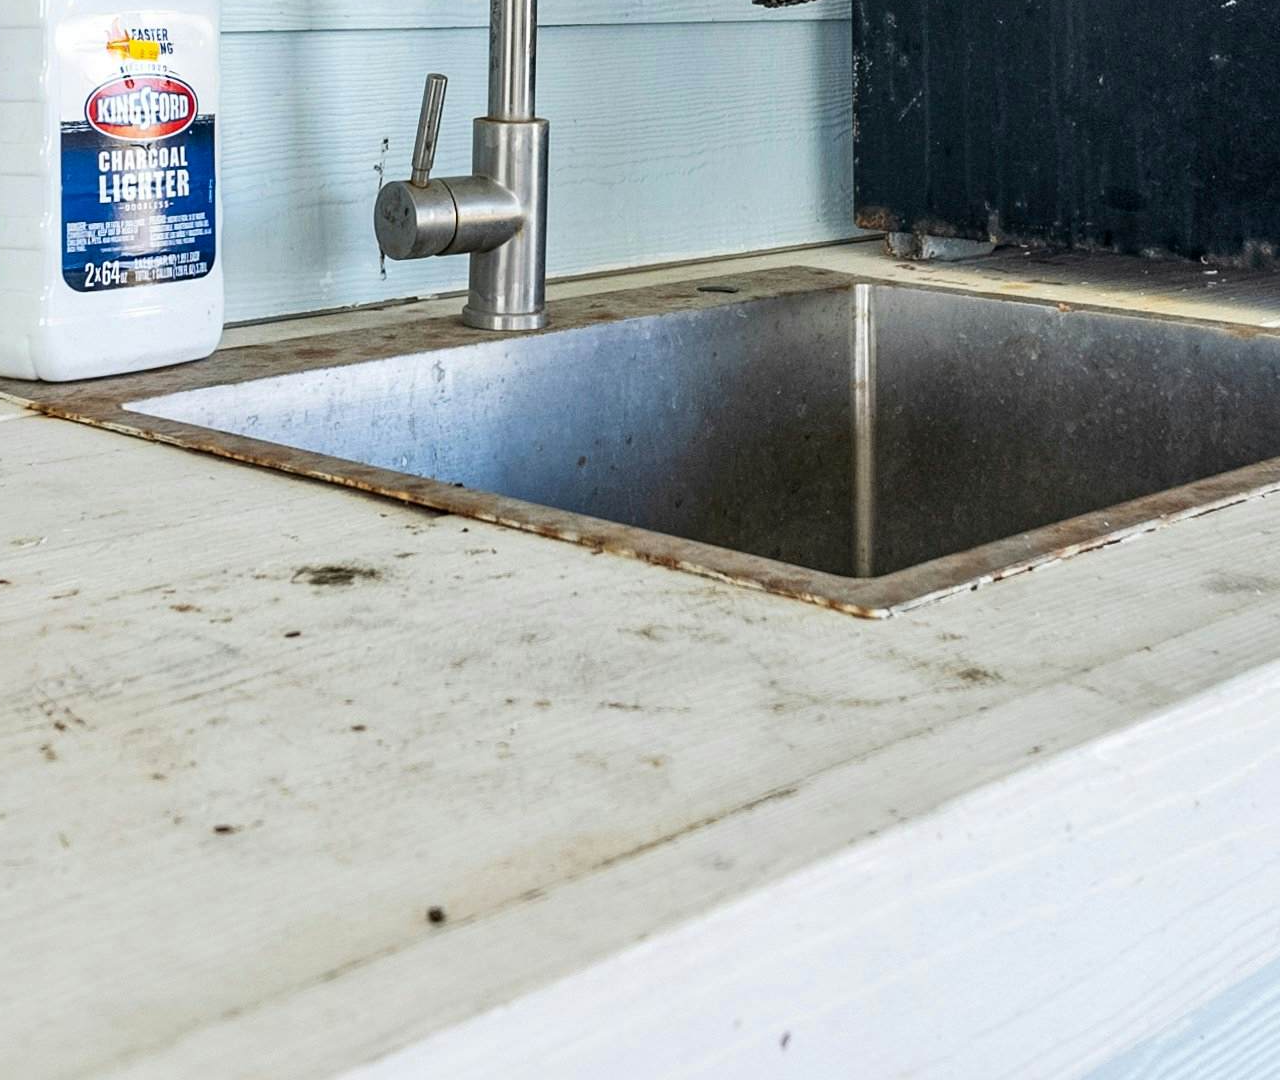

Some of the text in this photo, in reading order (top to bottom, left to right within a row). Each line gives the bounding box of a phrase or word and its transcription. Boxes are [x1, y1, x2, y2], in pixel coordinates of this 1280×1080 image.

[131, 28, 169, 41] FASTER
[96, 86, 190, 130] KINGSFORD
[98, 146, 188, 172] CHARCOAL
[99, 169, 190, 204] LIGHTER
